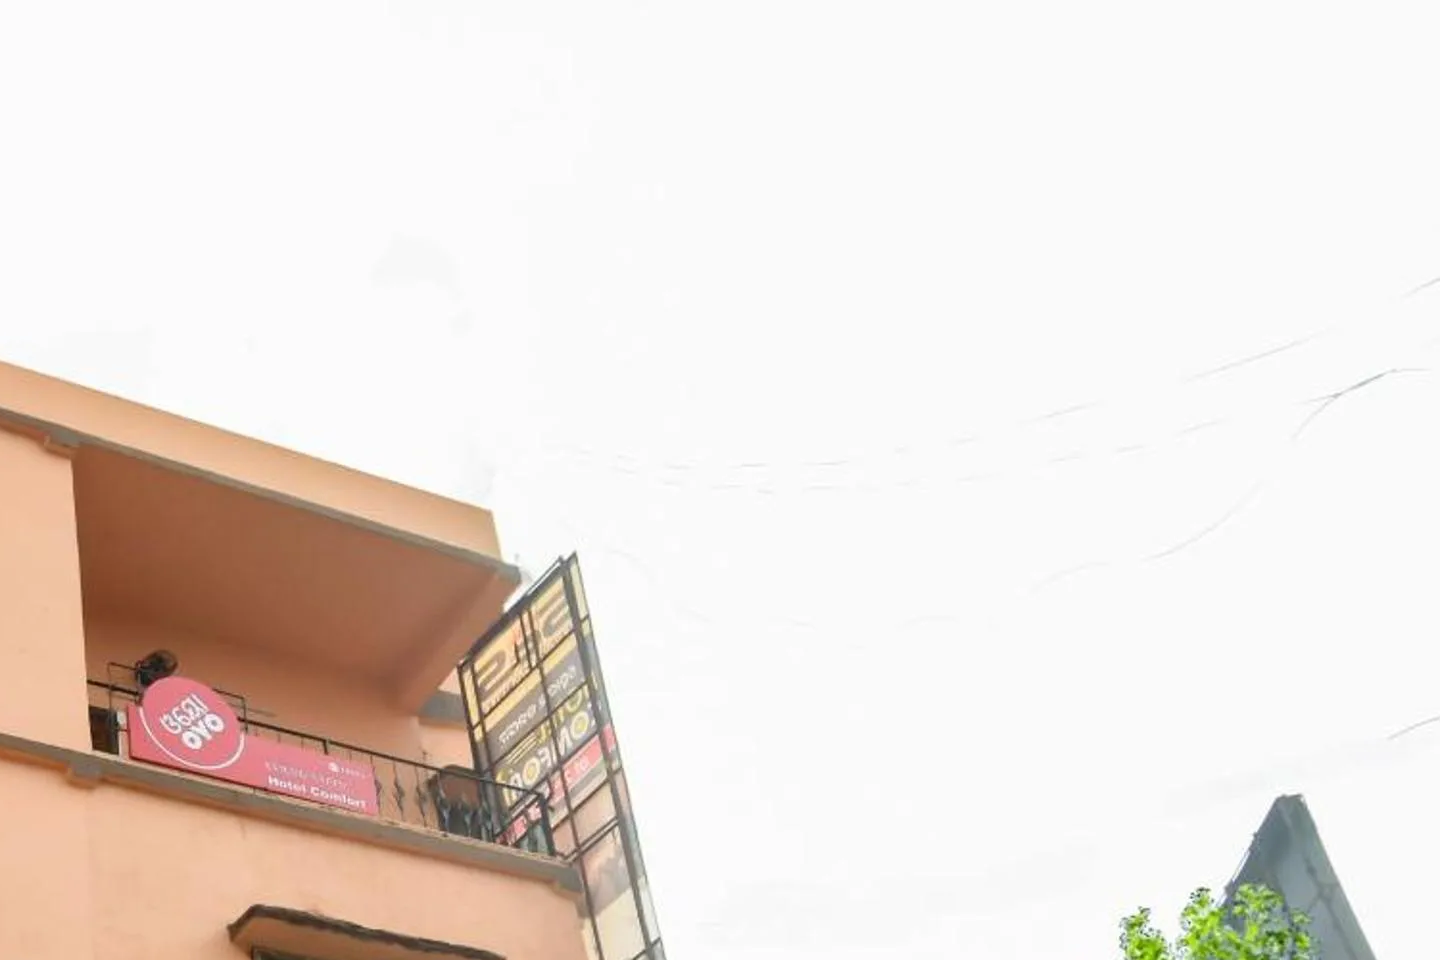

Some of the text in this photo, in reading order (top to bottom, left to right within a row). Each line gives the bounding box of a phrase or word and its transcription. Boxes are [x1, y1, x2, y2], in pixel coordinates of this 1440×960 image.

[181, 713, 225, 750] OYO
[267, 775, 367, 809] Hotel Comfort
